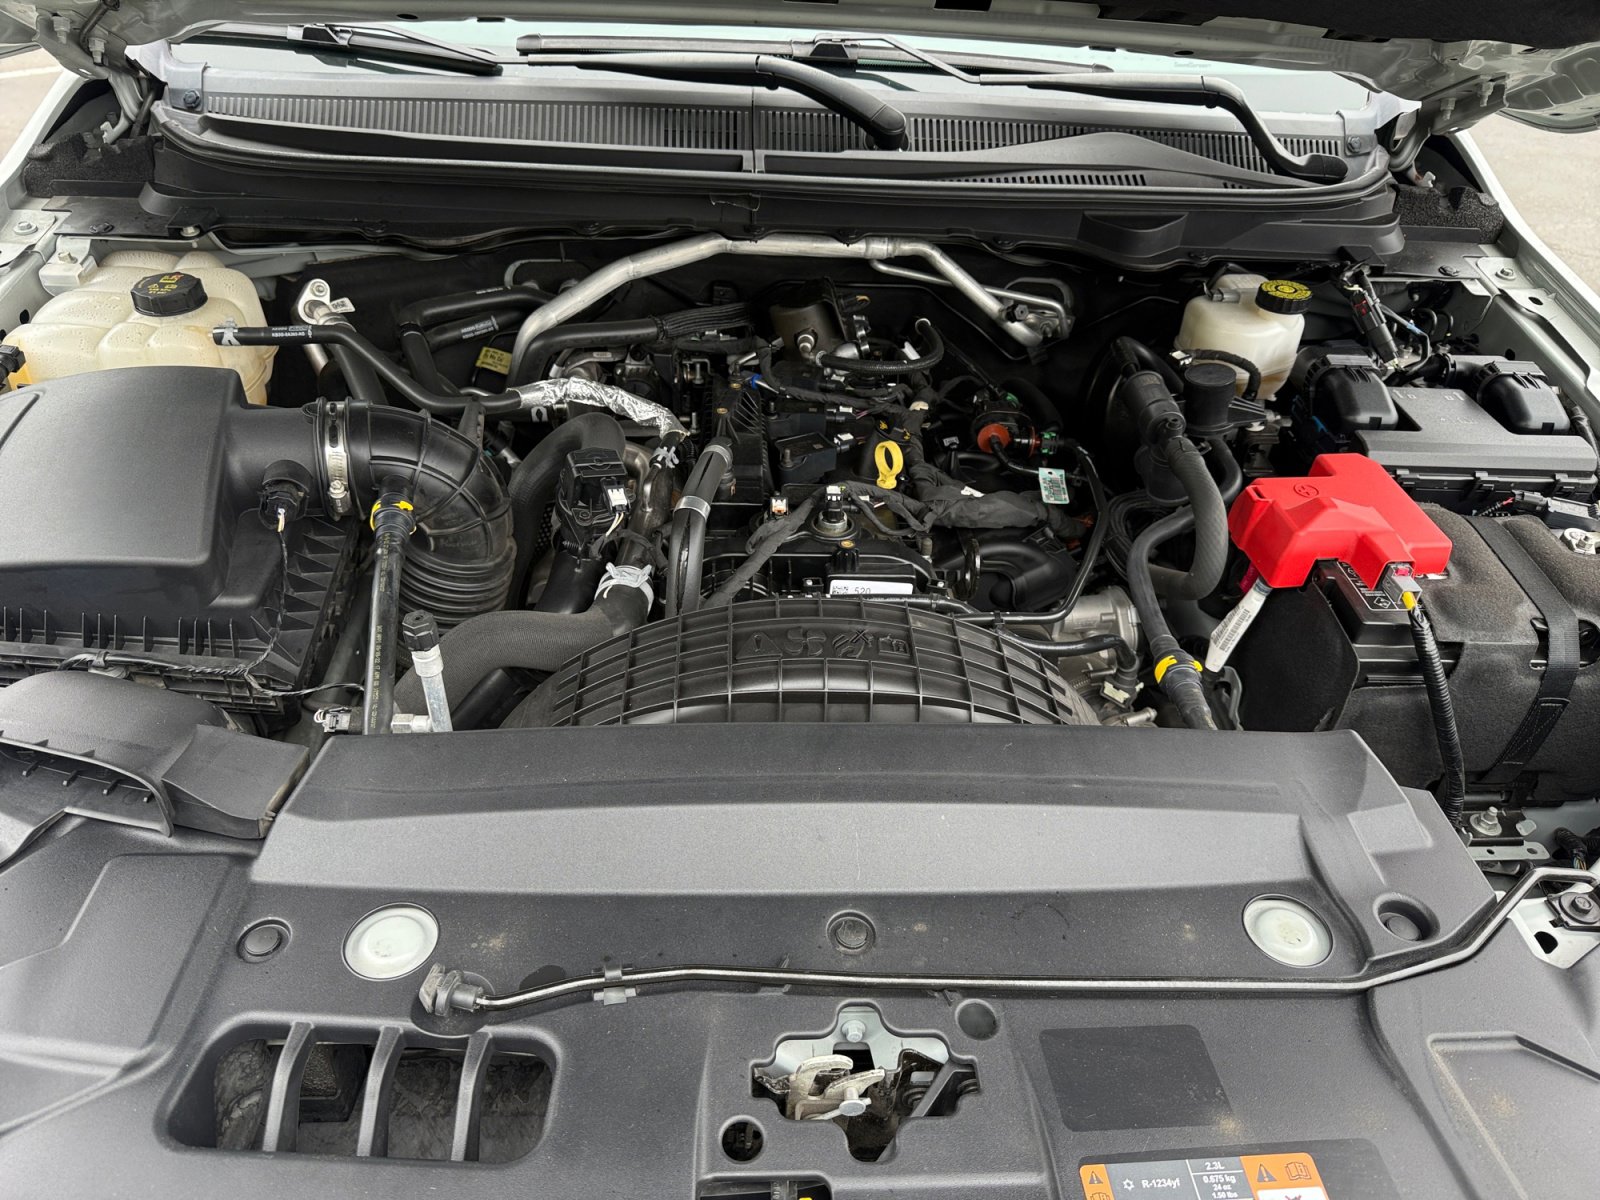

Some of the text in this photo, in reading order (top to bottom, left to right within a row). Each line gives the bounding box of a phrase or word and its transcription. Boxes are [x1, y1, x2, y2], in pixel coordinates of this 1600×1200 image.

[1204, 1161, 1225, 1170] 2.3L
[1141, 1177, 1180, 1189] R-1234yf
[1202, 1174, 1236, 1184] 0.675 kg
[1212, 1183, 1222, 1191] 24
